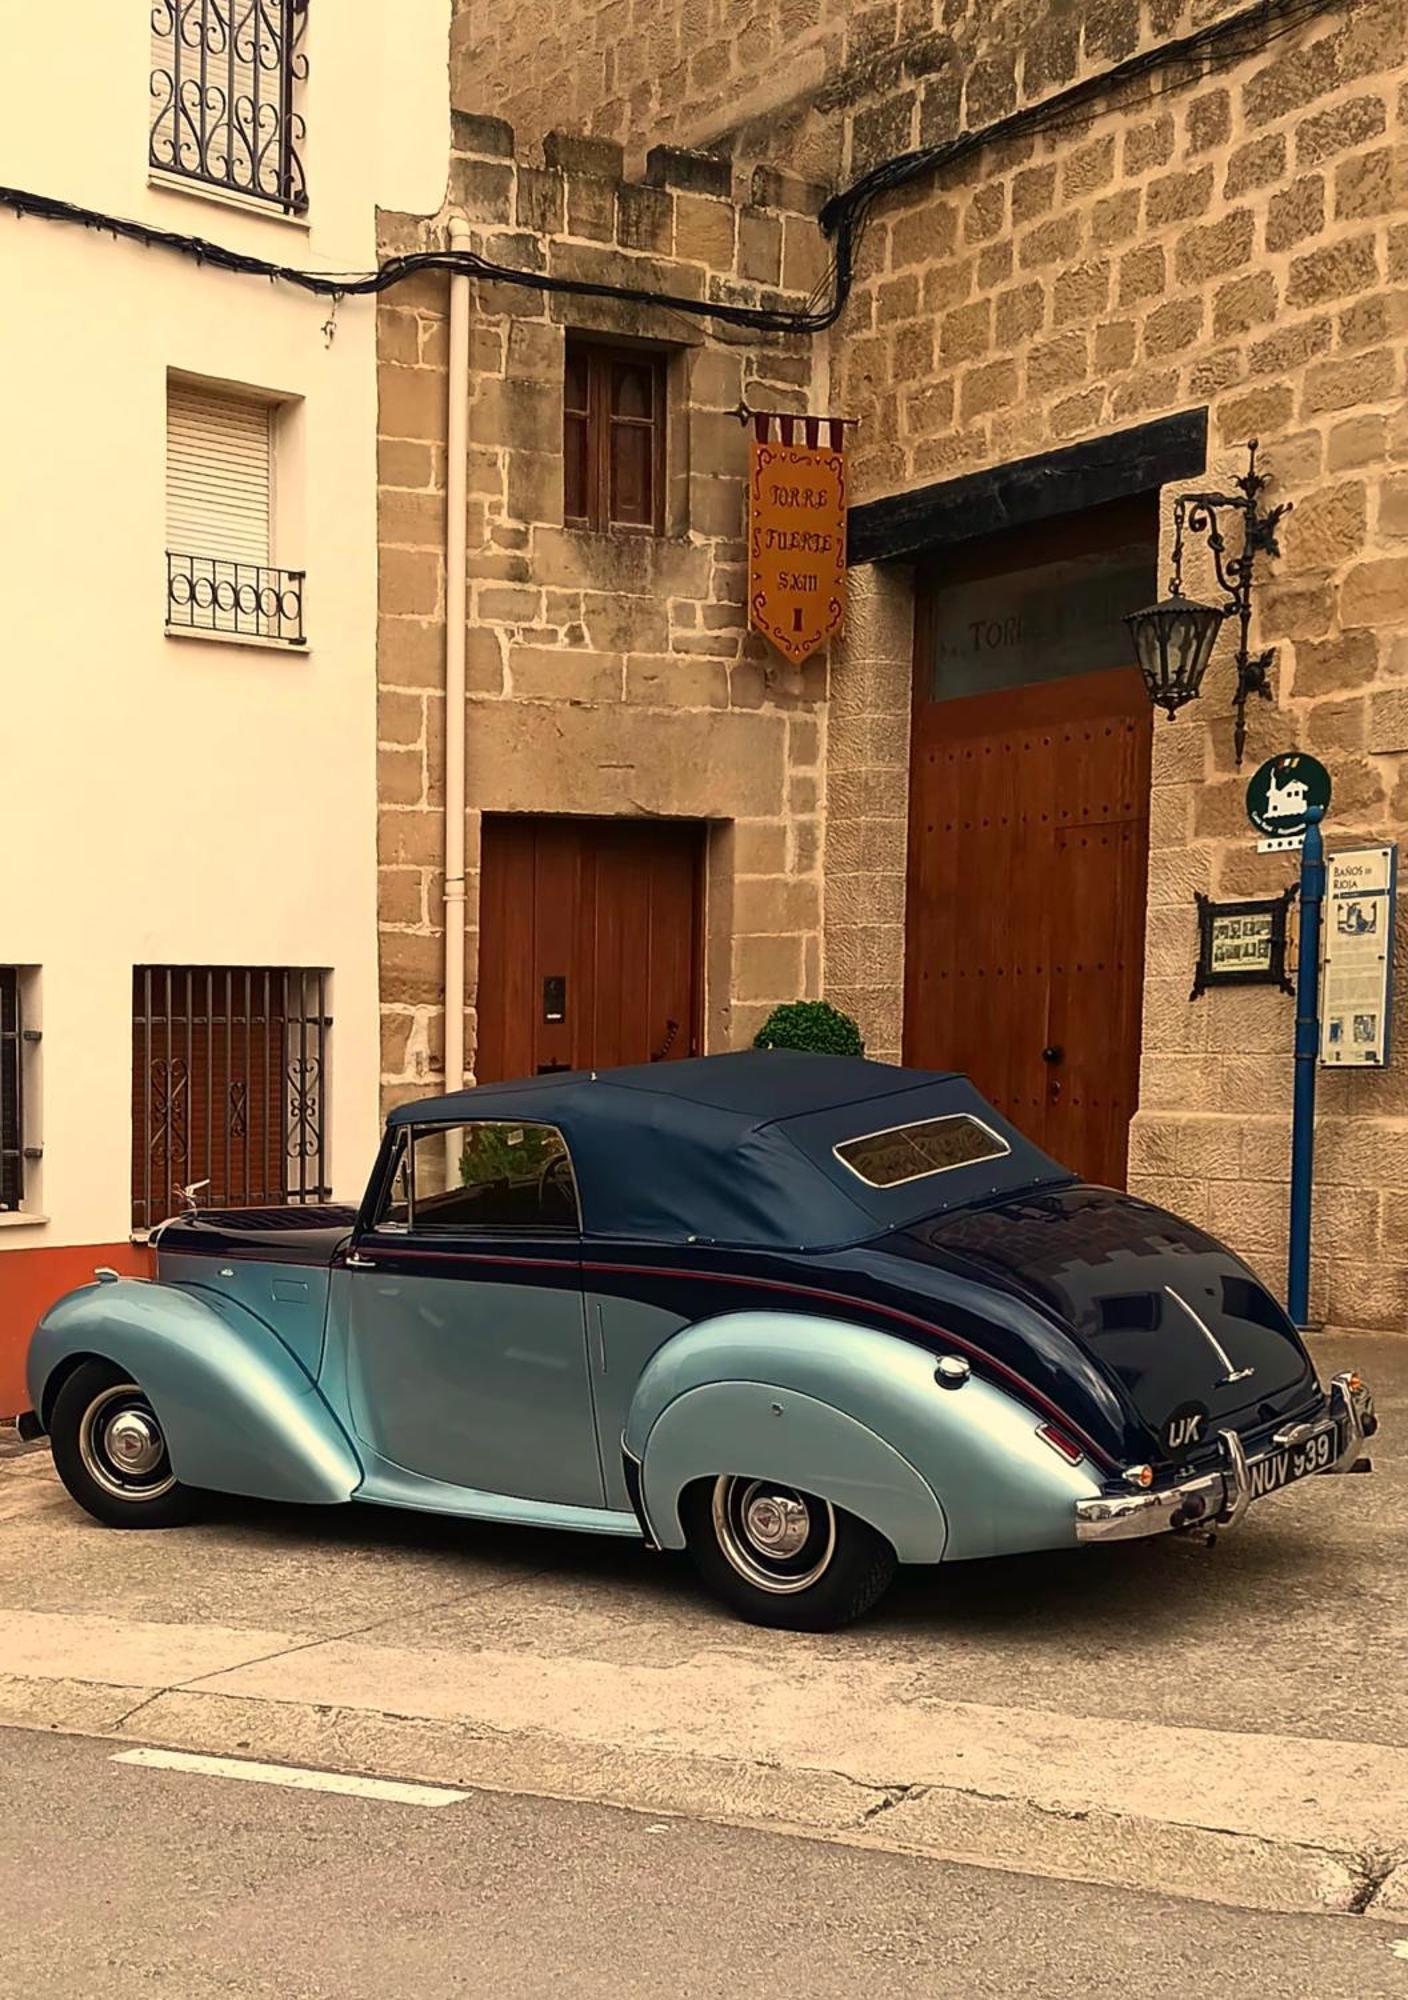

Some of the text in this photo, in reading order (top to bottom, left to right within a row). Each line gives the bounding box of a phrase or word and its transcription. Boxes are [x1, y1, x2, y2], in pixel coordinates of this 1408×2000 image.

[769, 485, 828, 510] TORRE
[765, 528, 833, 554] FUERTE
[1169, 1414, 1202, 1448] UK
[1251, 1451, 1289, 1497] NUV
